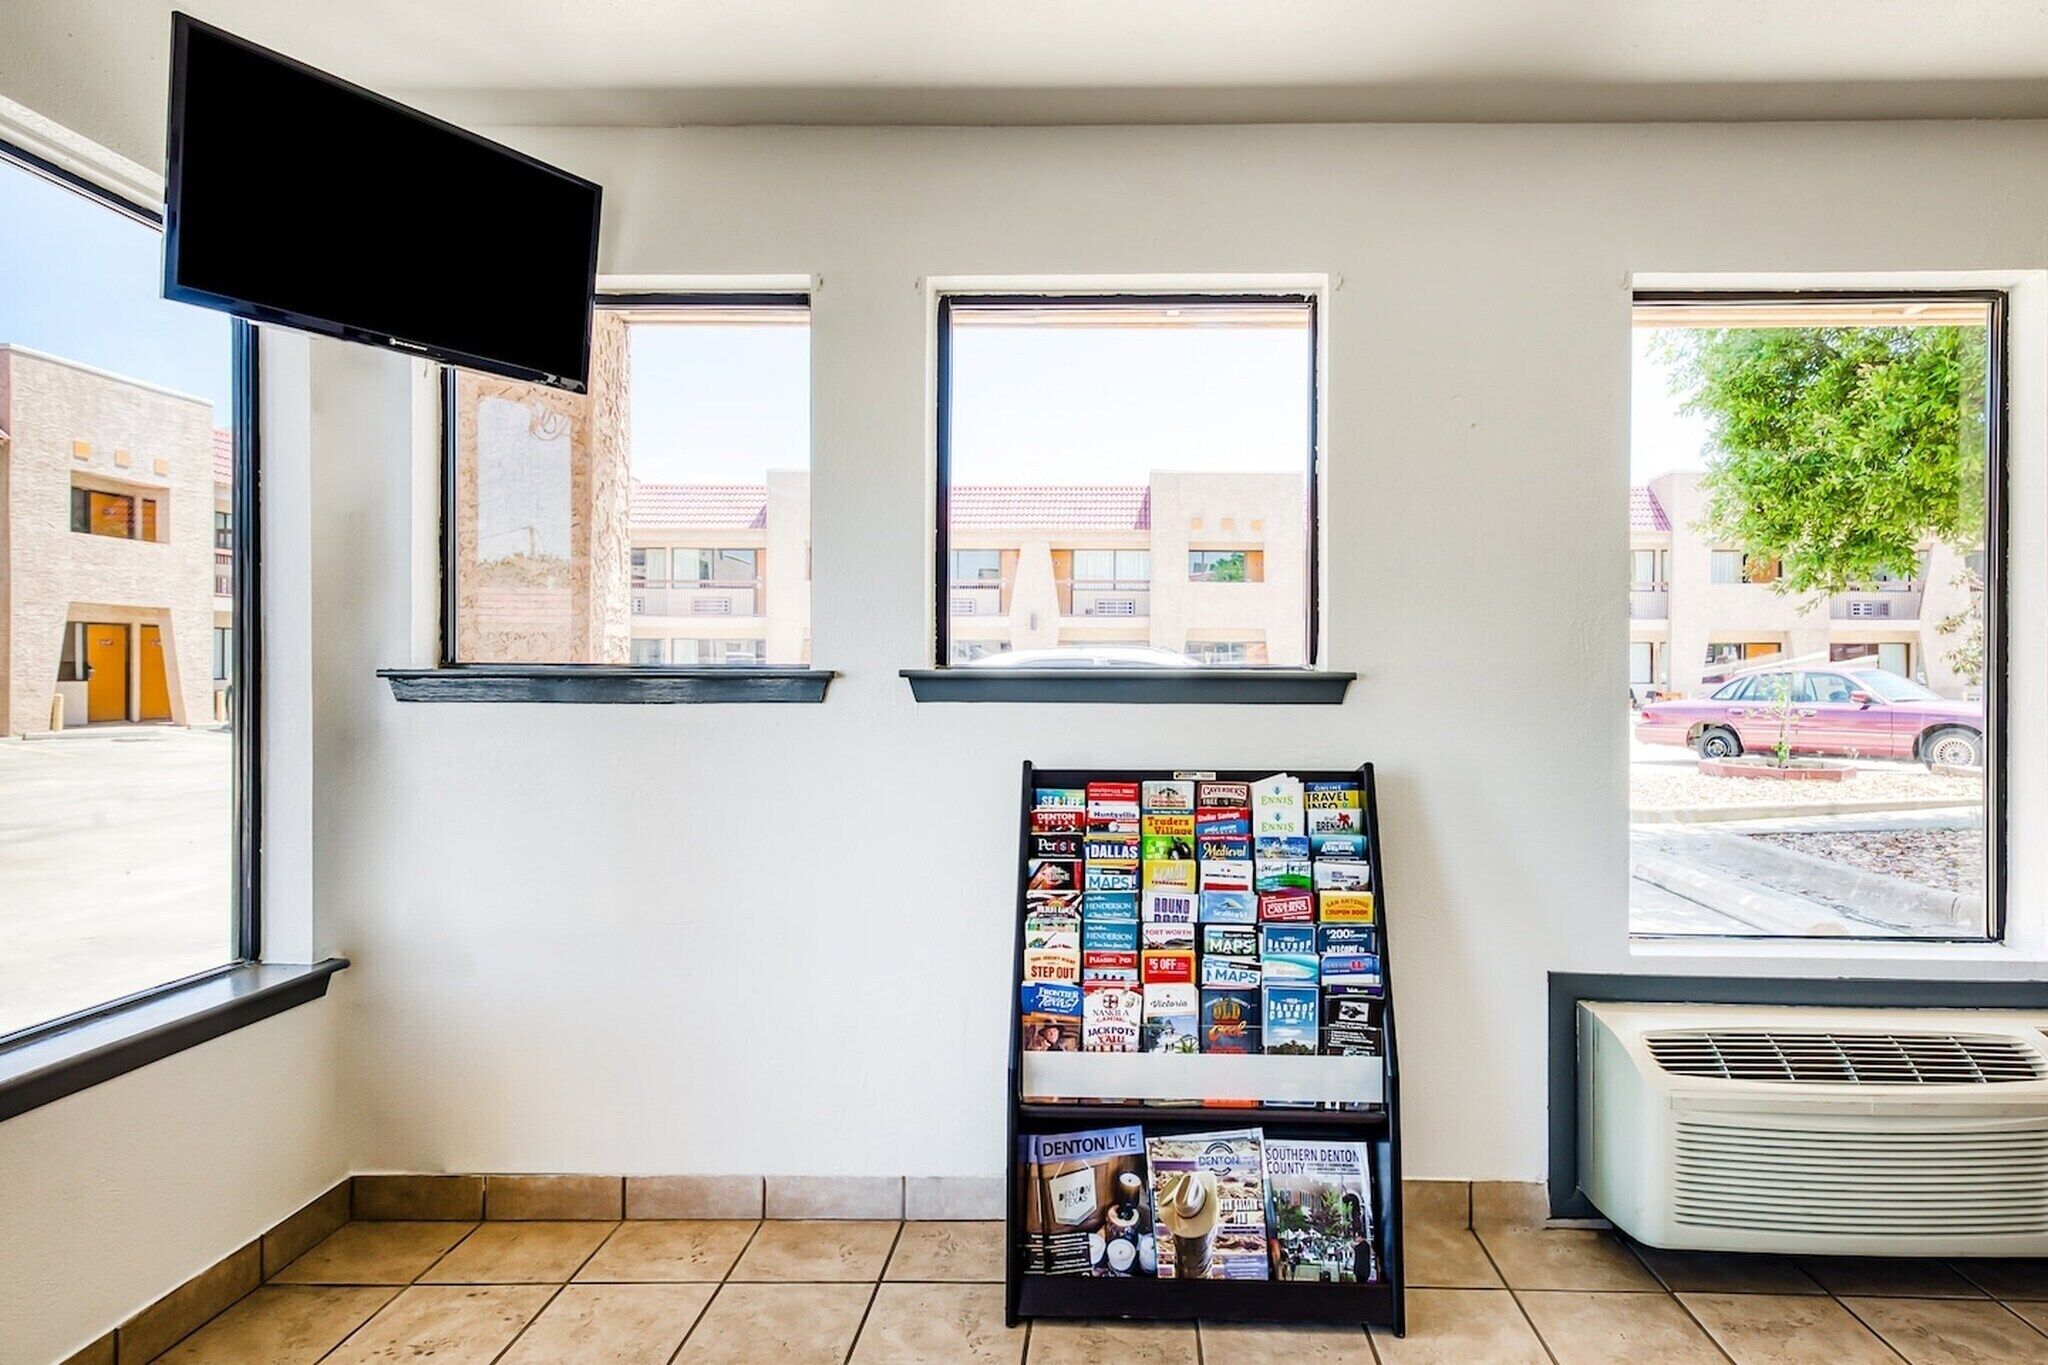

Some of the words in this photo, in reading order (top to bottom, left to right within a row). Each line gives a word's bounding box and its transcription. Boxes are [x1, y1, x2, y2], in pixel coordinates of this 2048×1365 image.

[1261, 796, 1294, 805] ENNIS
[1307, 792, 1349, 802] TRAVEL
[1094, 811, 1136, 819] Huntsville
[1147, 816, 1189, 826] Traders
[1154, 826, 1192, 836] Village
[1261, 822, 1294, 832] ENNIS
[1091, 844, 1138, 859] DALLAS
[1202, 842, 1247, 859] Medieval
[1089, 876, 1130, 889] MAPS
[1086, 902, 1132, 910] HENDERSON
[1154, 897, 1190, 914] ROUND
[1086, 932, 1133, 940] HENDERSON
[1209, 938, 1254, 953] MAPS
[1160, 958, 1177, 970] OFF
[1031, 965, 1054, 978] STEP
[1056, 967, 1075, 979] OUT
[1215, 969, 1257, 984] MAPS
[1150, 1000, 1187, 1008] Victoria
[1269, 1011, 1314, 1021] COUNTY
[1088, 1026, 1136, 1037] JACKPOTS
[1042, 1132, 1137, 1157] DENTONLIVE
[1265, 1147, 1318, 1162] SOUTHERN
[1320, 1149, 1359, 1163] DENTON
[1198, 1156, 1239, 1166] DENTON
[1267, 1161, 1305, 1174] COUNTY
